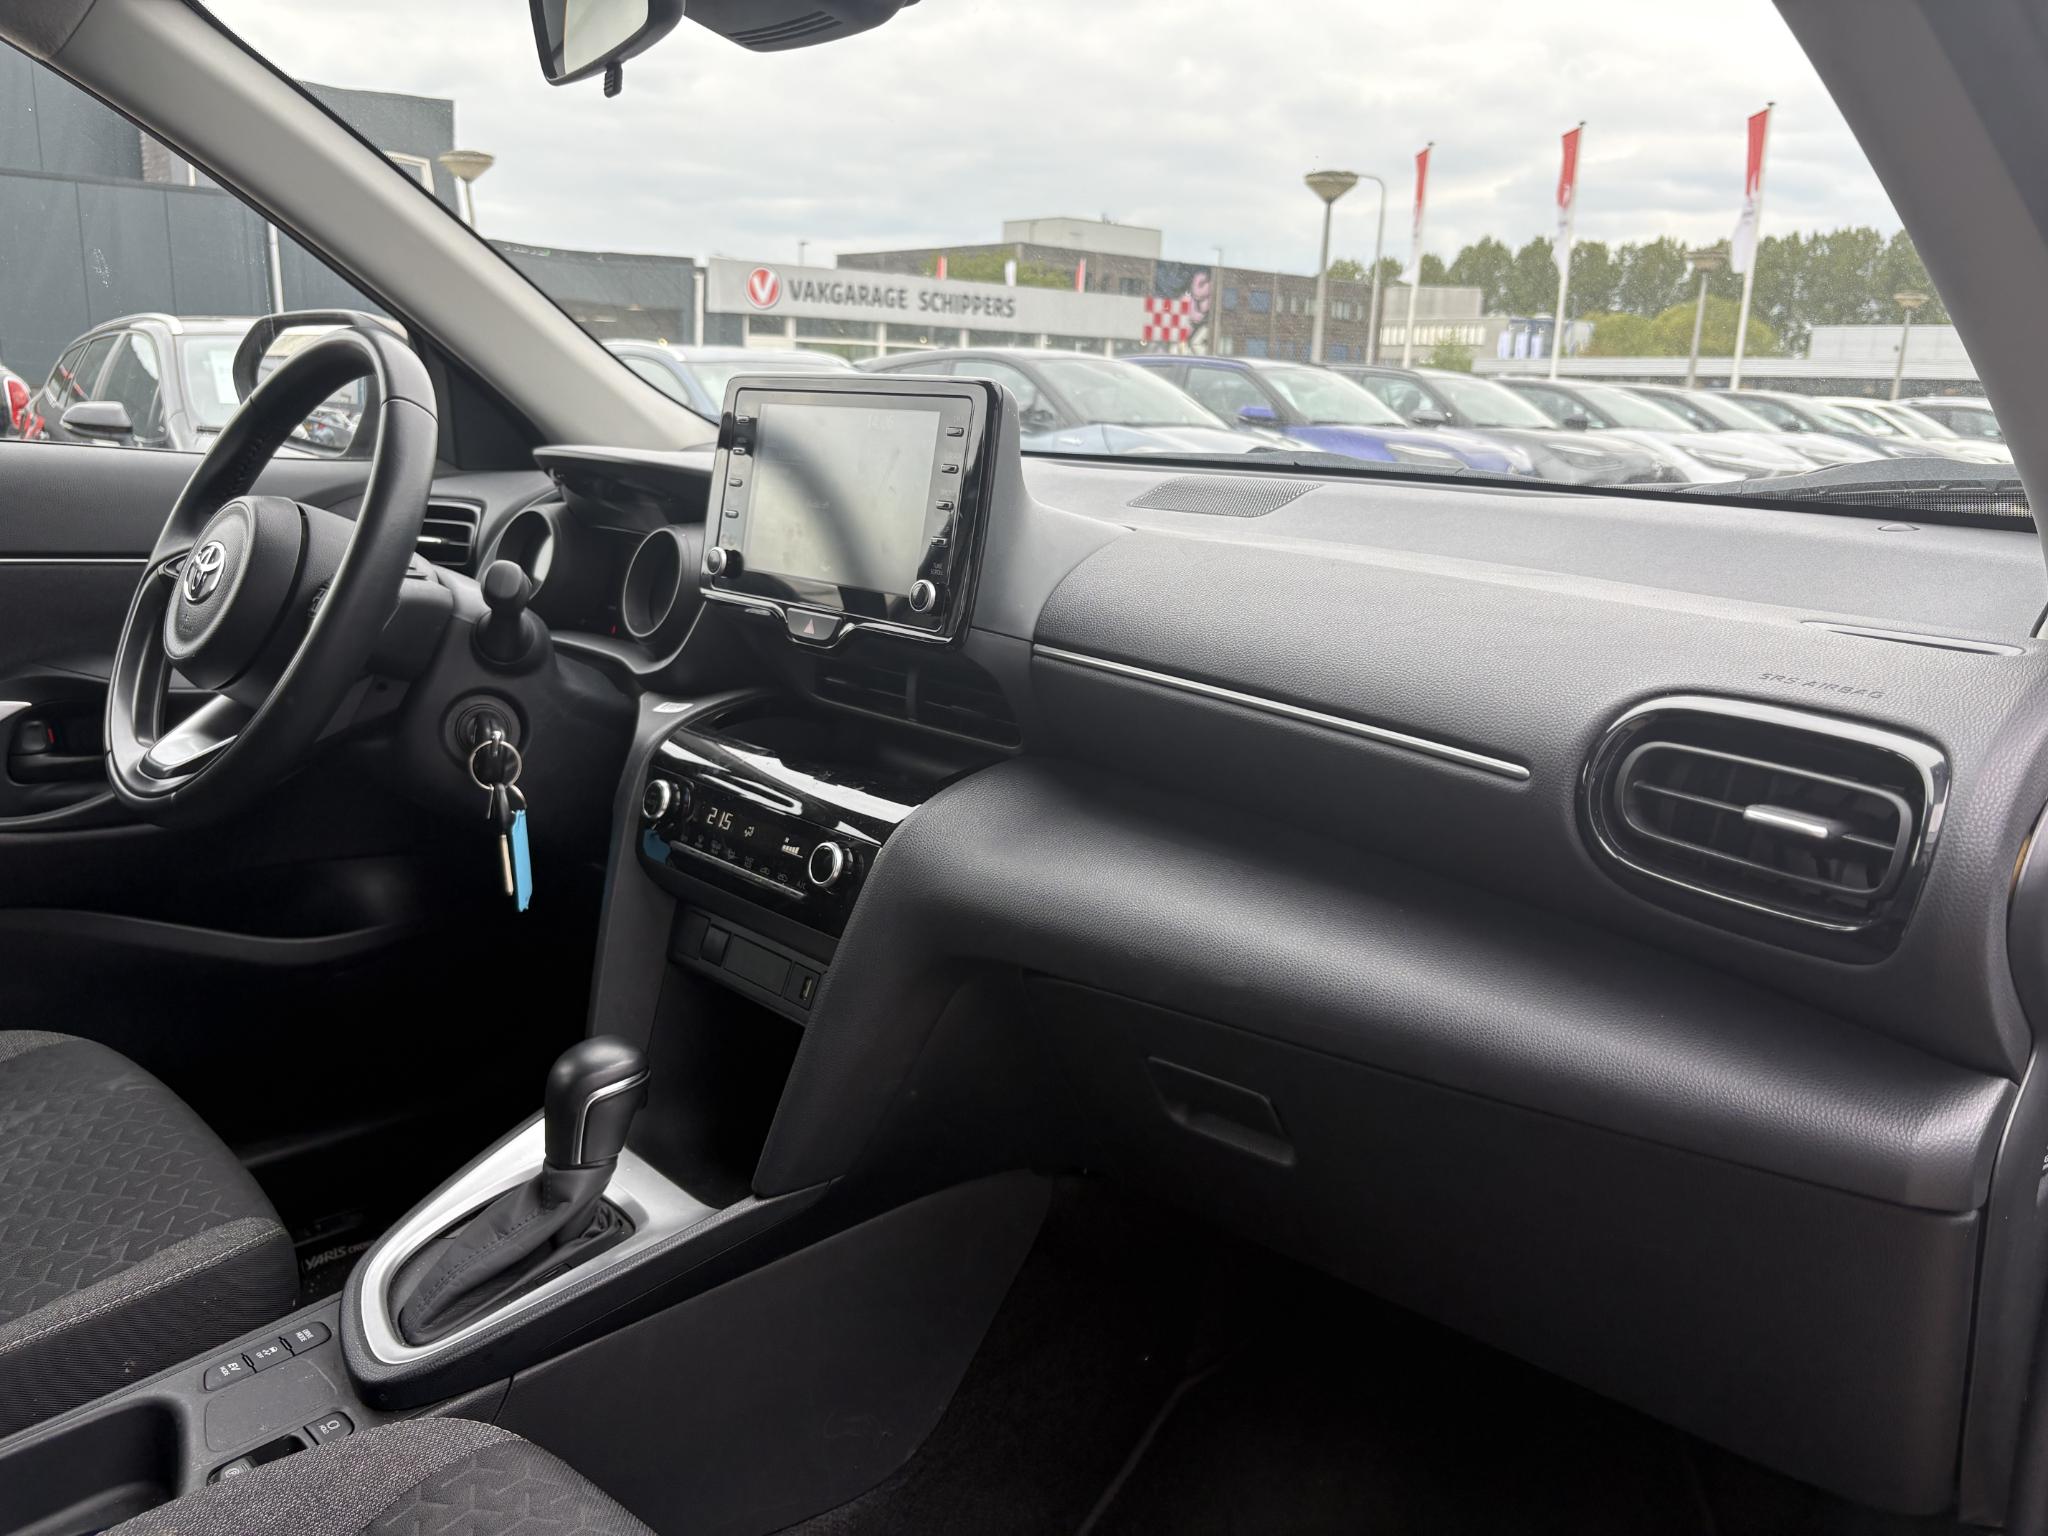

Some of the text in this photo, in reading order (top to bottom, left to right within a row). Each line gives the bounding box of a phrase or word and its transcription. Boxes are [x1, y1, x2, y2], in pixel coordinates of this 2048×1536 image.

[788, 279, 1016, 318] VAKGARAGE SCHIPPERS
[1759, 673, 1886, 699] SRS AIRBAG
[305, 1246, 347, 1270] YARIS
[227, 1362, 241, 1371] EV
